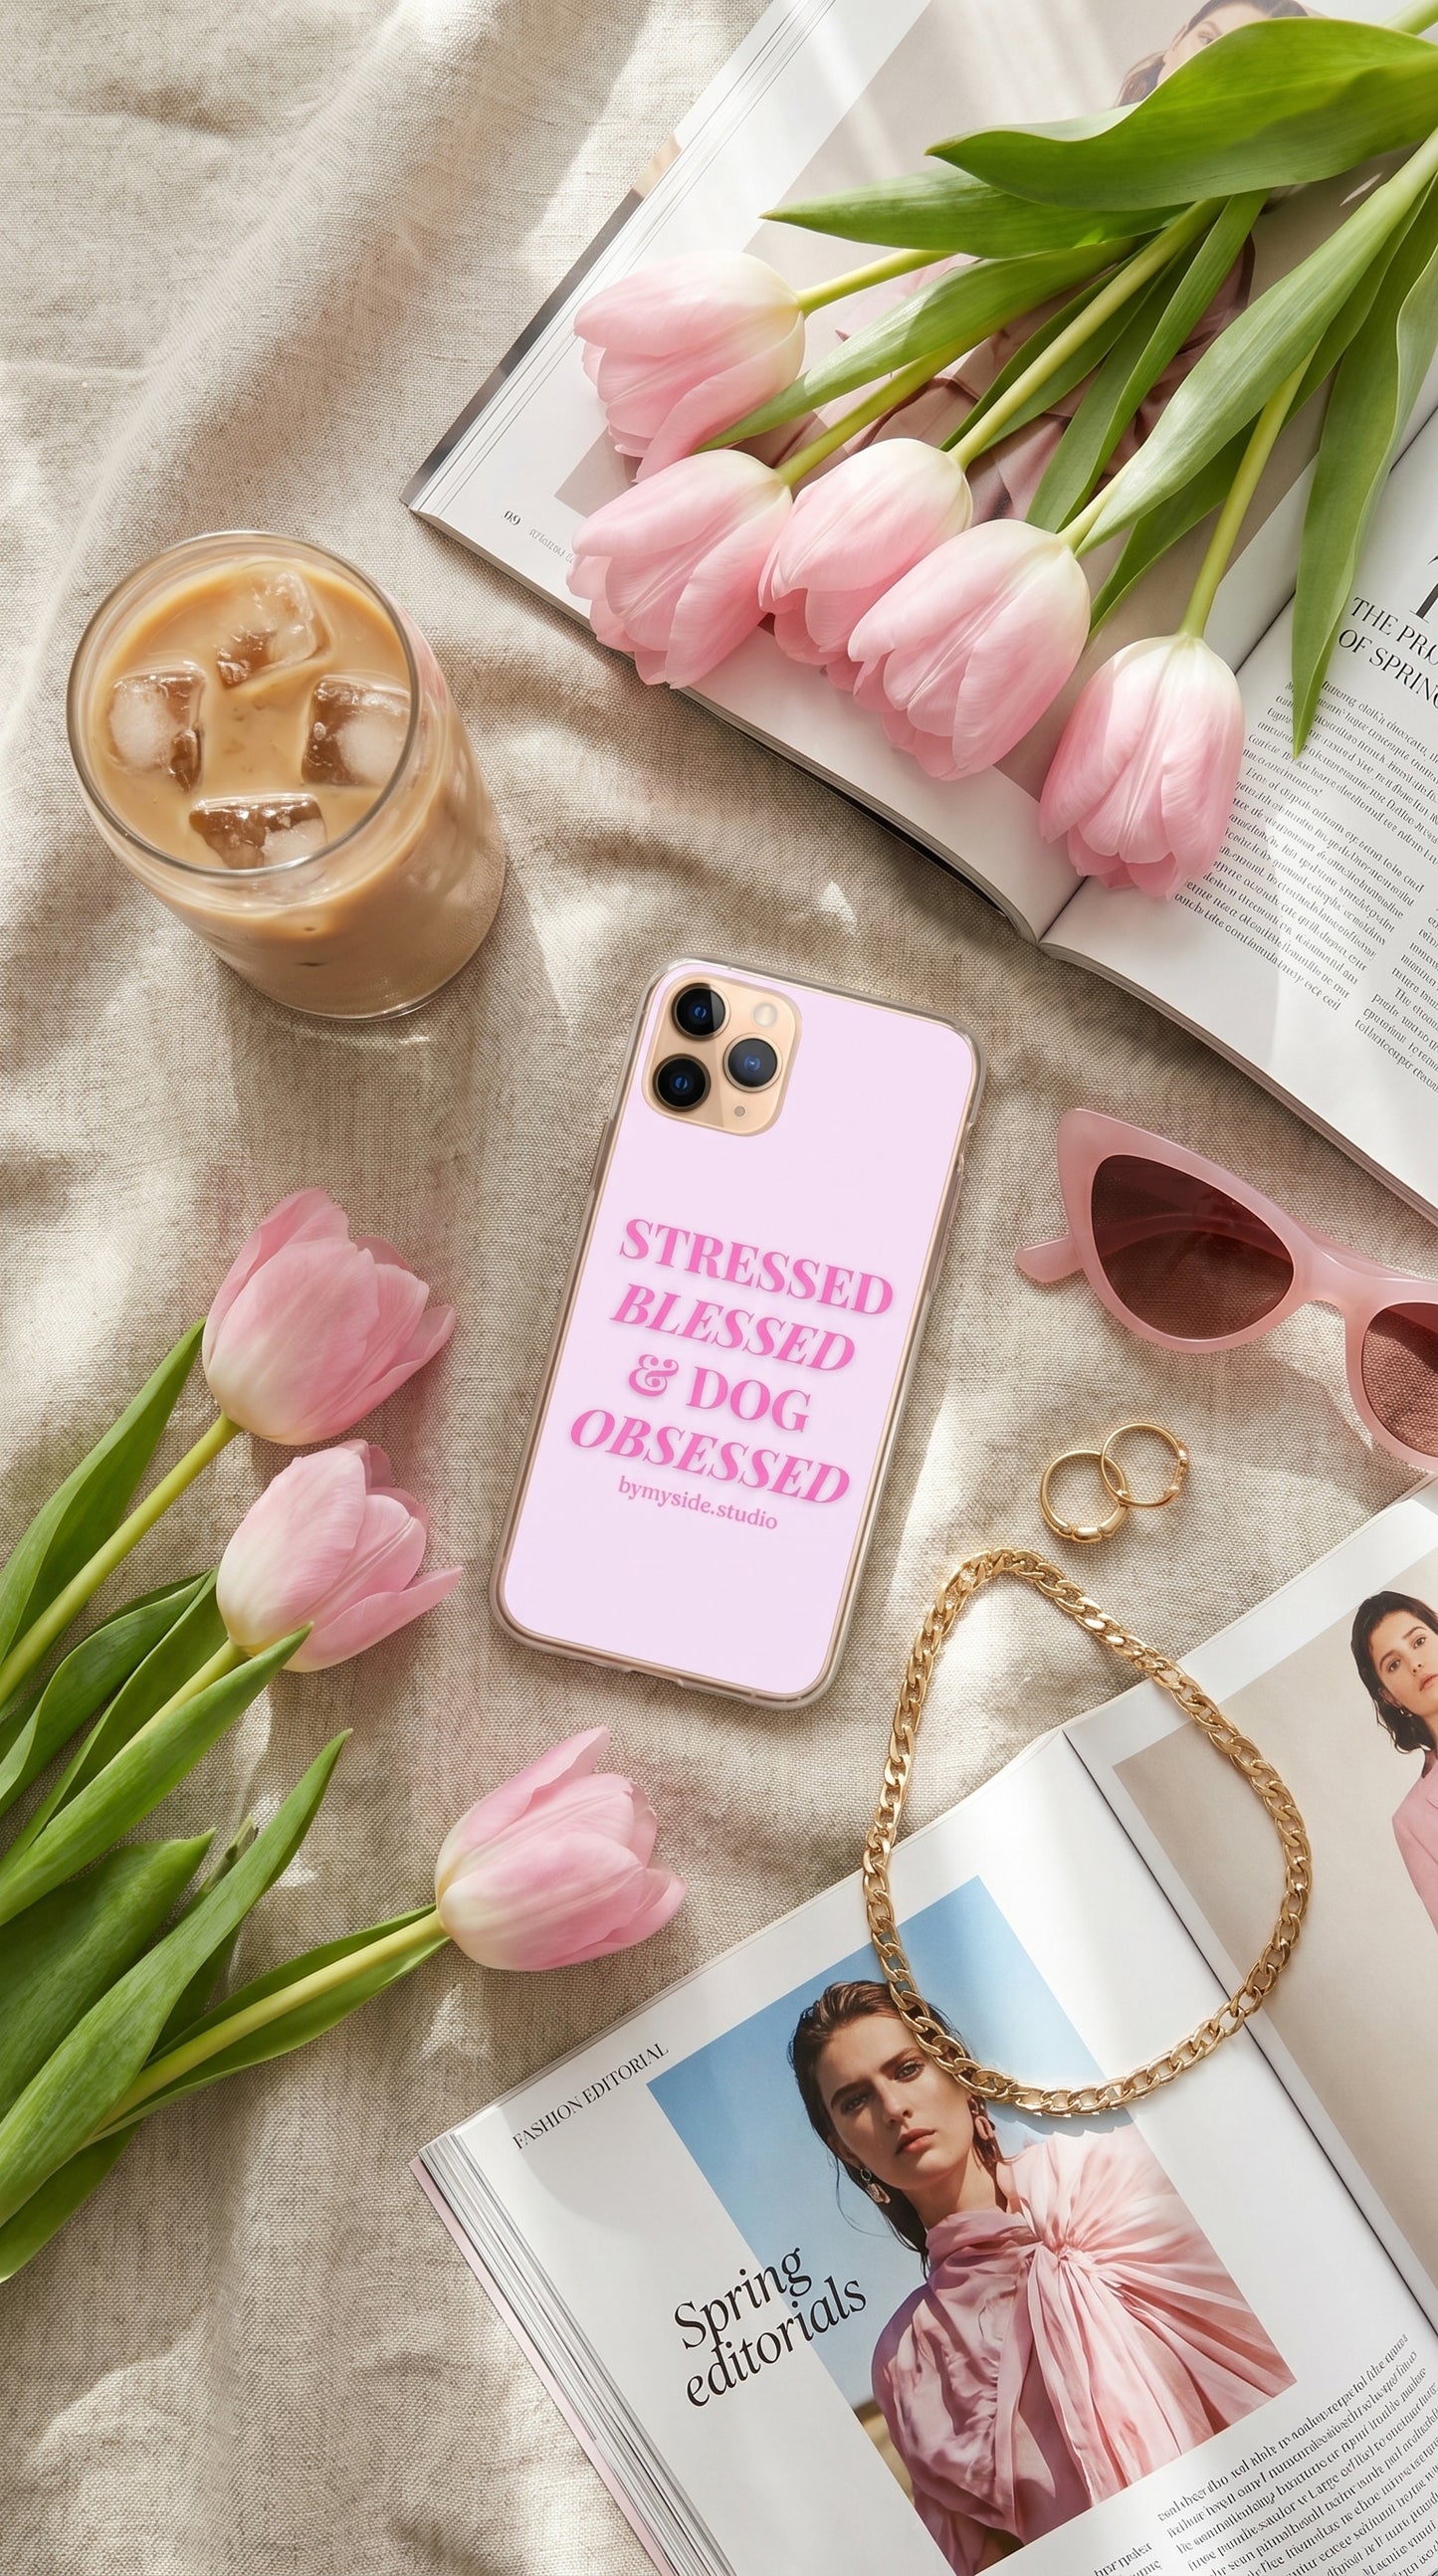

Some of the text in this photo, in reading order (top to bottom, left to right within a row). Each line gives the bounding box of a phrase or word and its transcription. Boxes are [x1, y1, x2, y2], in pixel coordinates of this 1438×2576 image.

[1338, 629, 1373, 654] OF
[1350, 596, 1399, 636] THE
[619, 1218, 895, 1315] STRESSED
[609, 1283, 857, 1372] BLESSED
[627, 1353, 812, 1434] & DOG
[569, 1408, 851, 1504] OBSESSED
[617, 1475, 779, 1530] bymyside.studio
[512, 2042, 670, 2150] FASHION EDITORIAL
[674, 2247, 813, 2350] Spring
[686, 2275, 867, 2408] editorials
